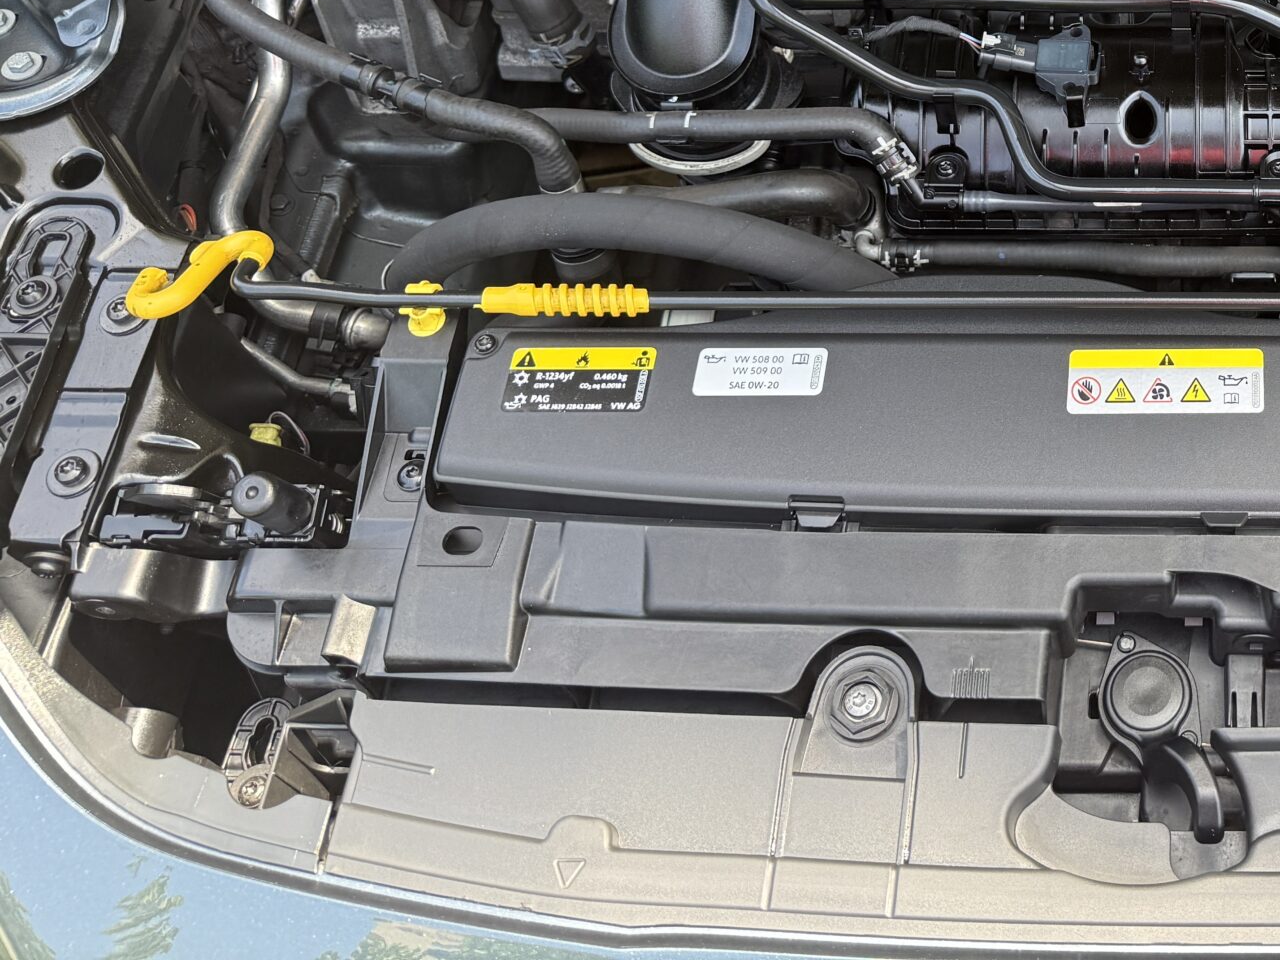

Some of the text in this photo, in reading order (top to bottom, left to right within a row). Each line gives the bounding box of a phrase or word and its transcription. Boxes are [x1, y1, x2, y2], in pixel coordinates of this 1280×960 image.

[734, 355, 784, 363] VW 508 00
[732, 367, 783, 375] VW 509 00
[535, 372, 575, 382] R-1234yf
[617, 373, 628, 382] kg
[728, 381, 780, 389] SAE 0W-20
